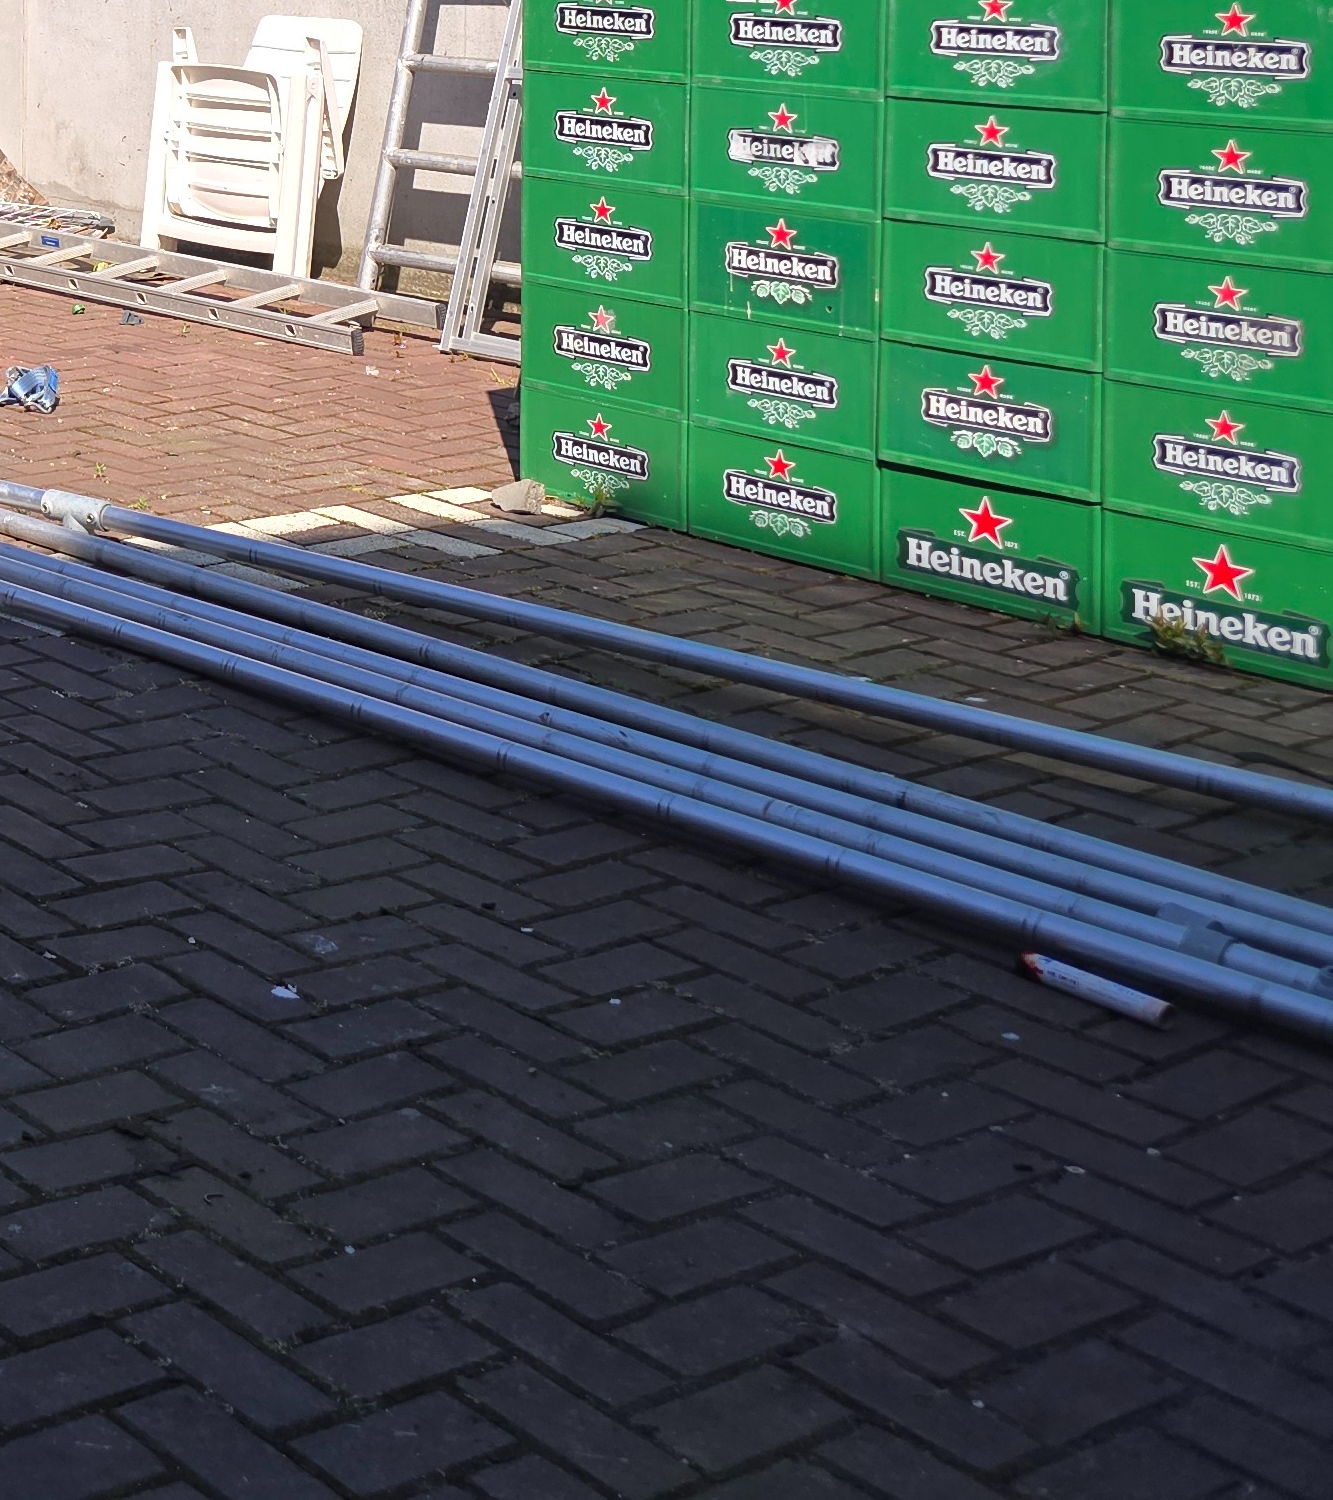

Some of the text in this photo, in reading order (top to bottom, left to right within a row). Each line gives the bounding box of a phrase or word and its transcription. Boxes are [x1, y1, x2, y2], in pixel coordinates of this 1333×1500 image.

[563, 9, 648, 32] Heineken
[738, 22, 834, 45] Heineken
[940, 28, 1050, 53] Heineken
[1171, 45, 1298, 71] Heineken
[562, 118, 646, 142] Heineken
[937, 152, 1047, 180] Heineken
[1171, 178, 1295, 209] Heineken
[563, 225, 646, 254] Heineken
[732, 248, 833, 281] Heineken
[935, 275, 1043, 308] Heineken
[1166, 313, 1291, 347] Heineken
[561, 332, 643, 364] Heineken
[736, 367, 830, 400] Heineken
[929, 396, 1044, 434] Heineken
[561, 439, 641, 472] Heineken
[1165, 443, 1289, 483] Heineken
[731, 478, 831, 517] Heineken
[906, 538, 1069, 600] Heineken
[1132, 589, 1320, 658] Heineken
